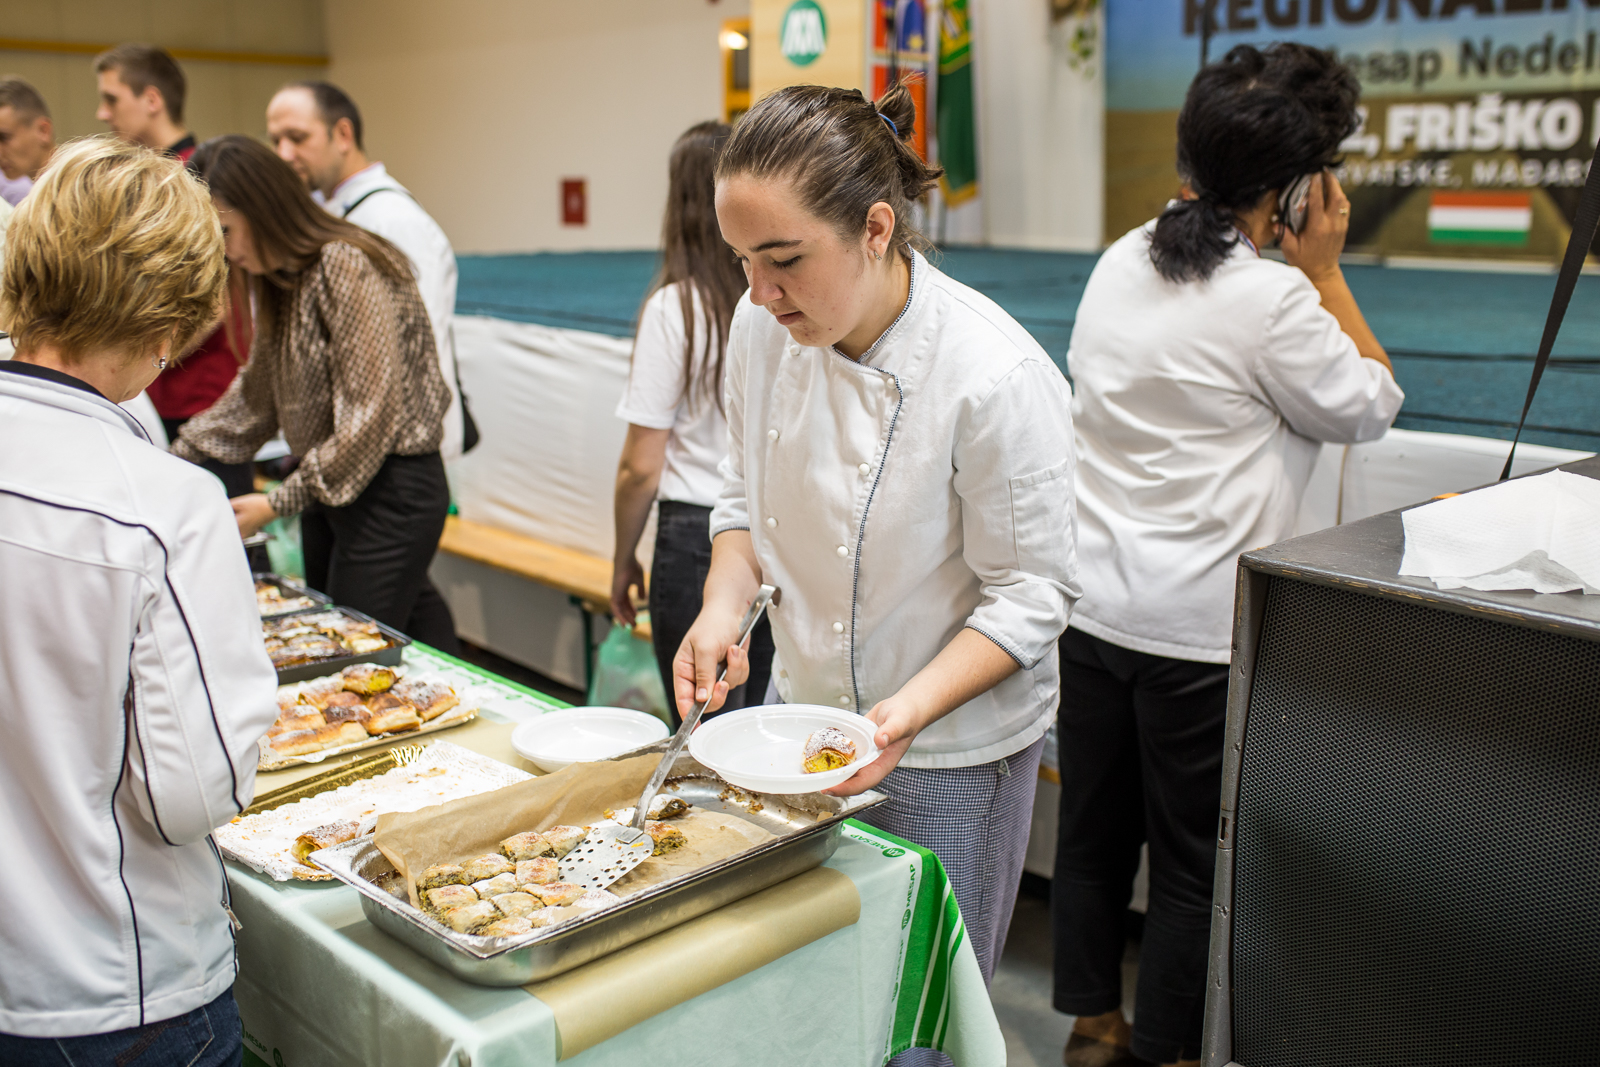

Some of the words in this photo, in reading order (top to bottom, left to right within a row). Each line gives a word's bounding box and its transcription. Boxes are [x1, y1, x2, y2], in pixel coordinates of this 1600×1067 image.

[1329, 45, 1443, 92] esap
[1457, 31, 1600, 79] Nedel
[1385, 92, 1583, 151] FRIŠKO
